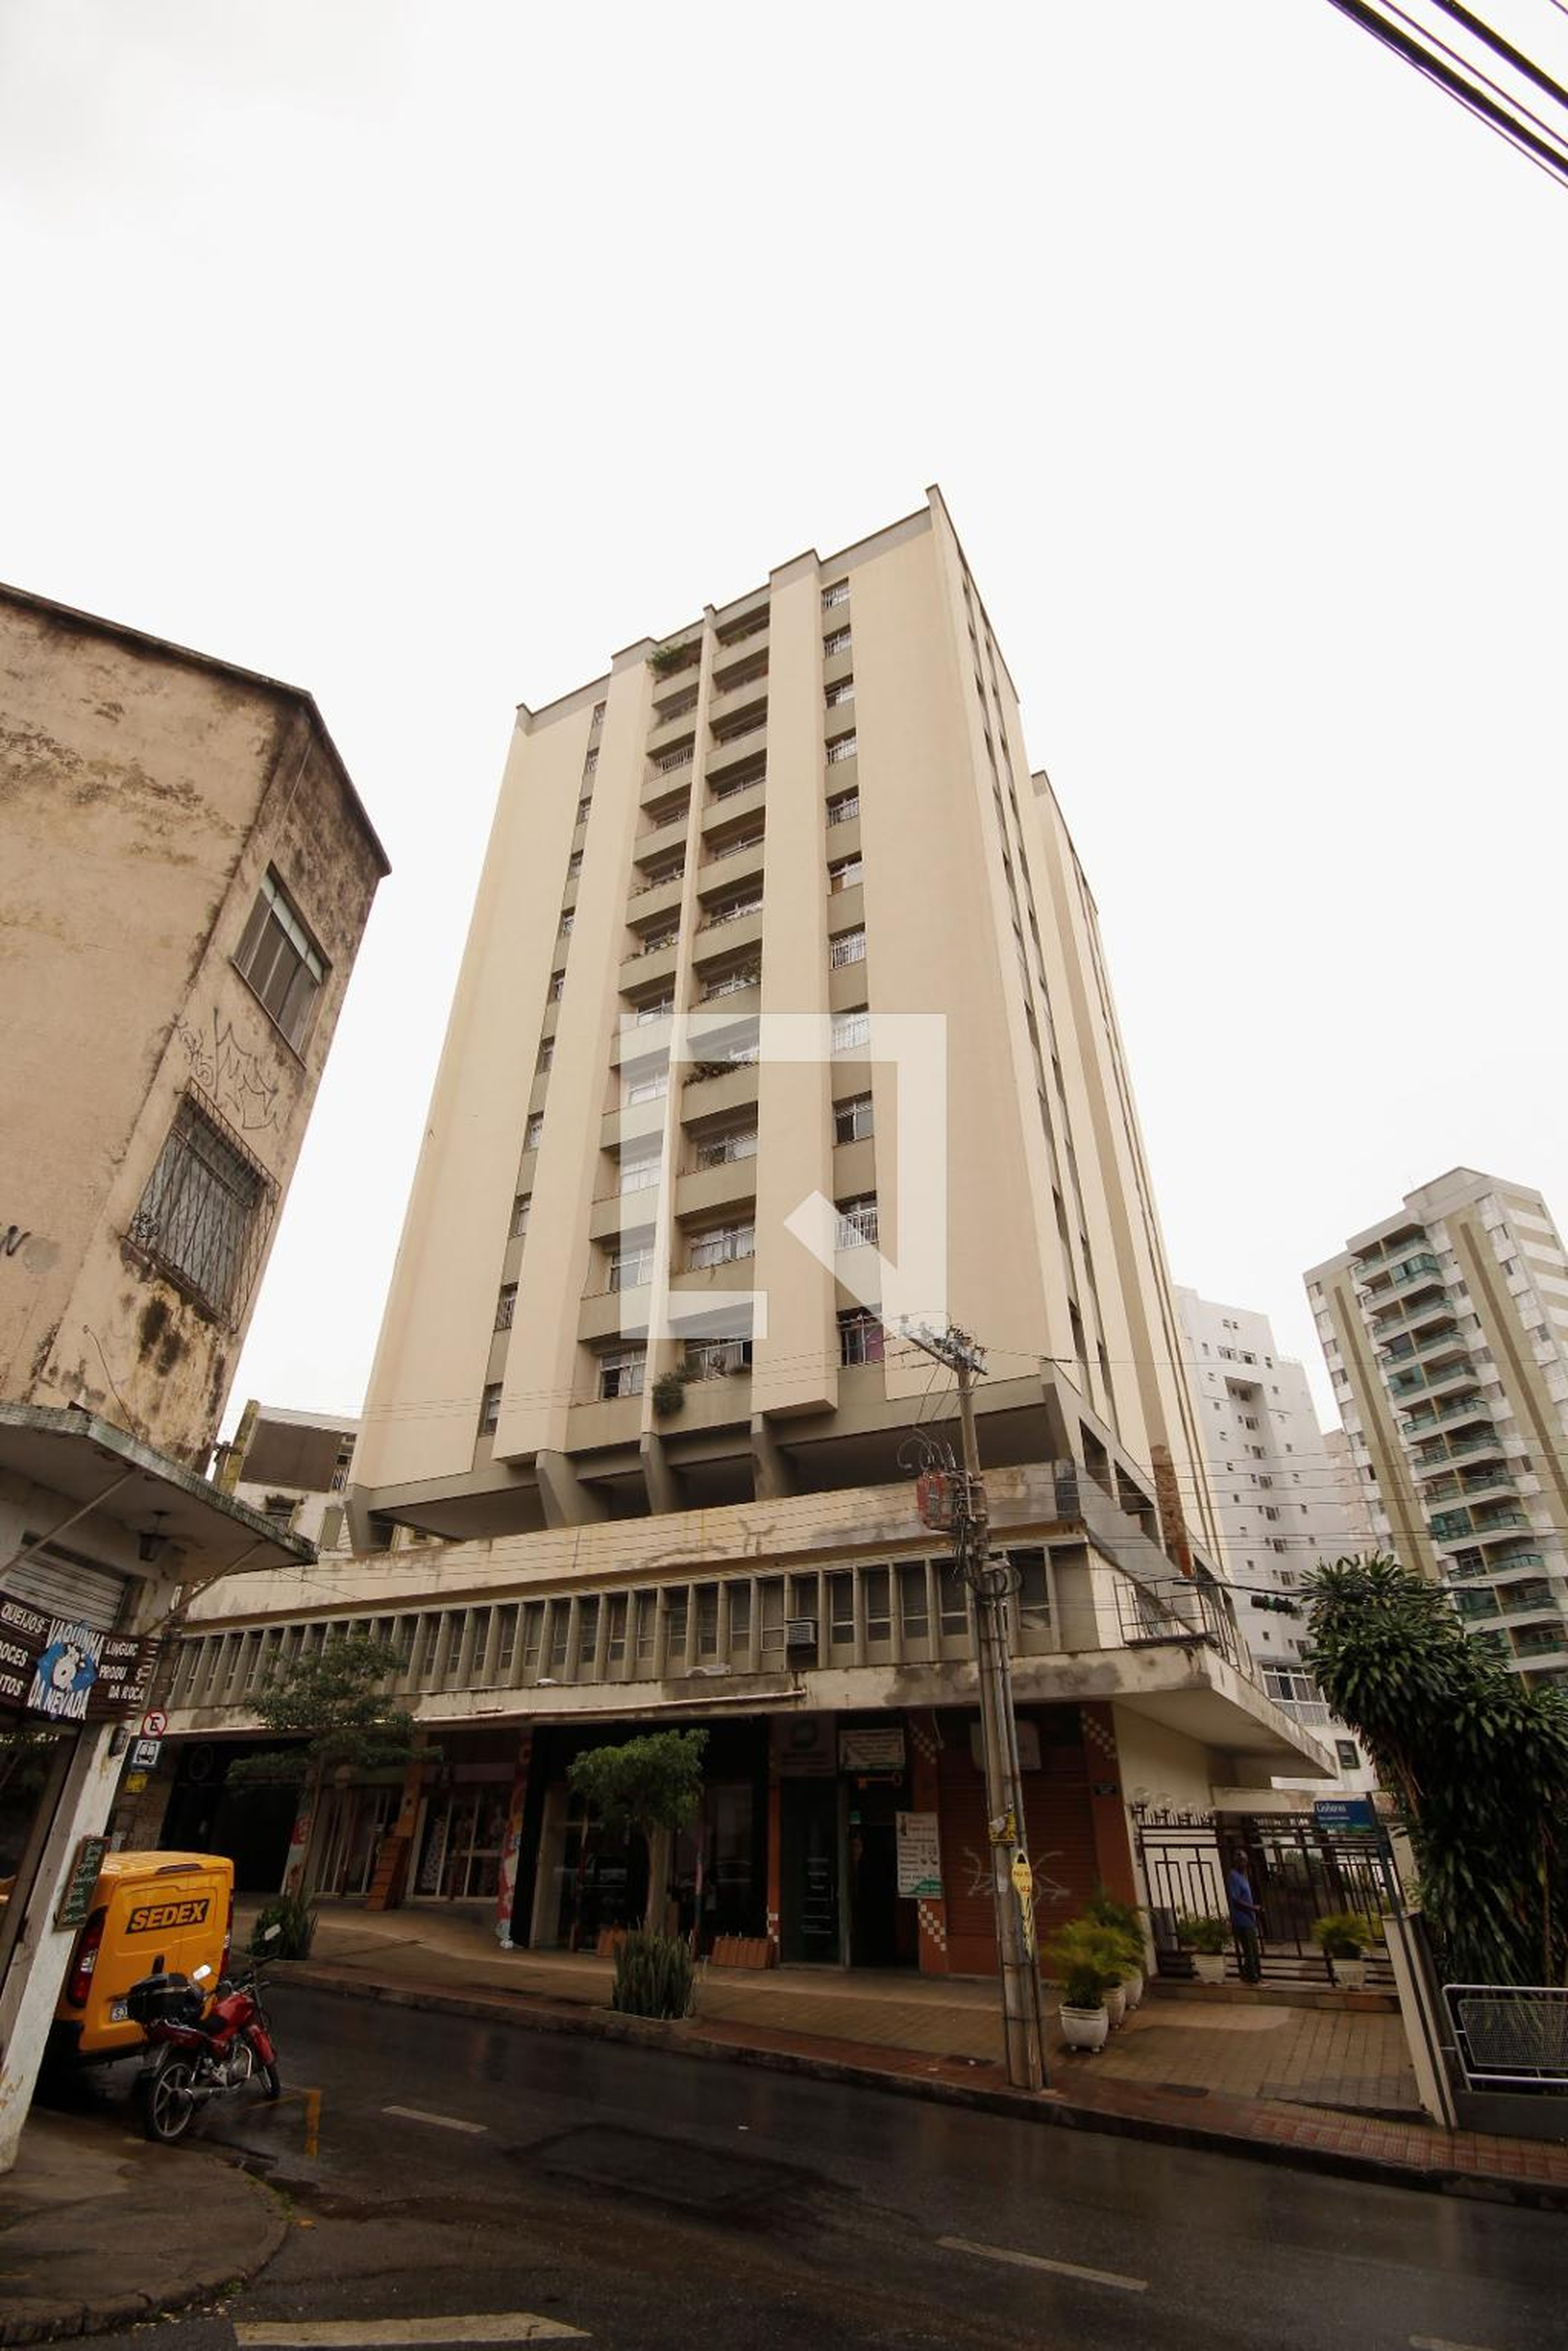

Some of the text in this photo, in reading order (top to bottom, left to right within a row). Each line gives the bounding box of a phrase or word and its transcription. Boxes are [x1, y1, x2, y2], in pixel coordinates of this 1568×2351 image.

[1, 1603, 45, 1633] QUEIJOS
[46, 1617, 105, 1667] VAQUINHA
[27, 1668, 91, 1720] DA NEVADA
[131, 1901, 207, 1930] SEDEX
